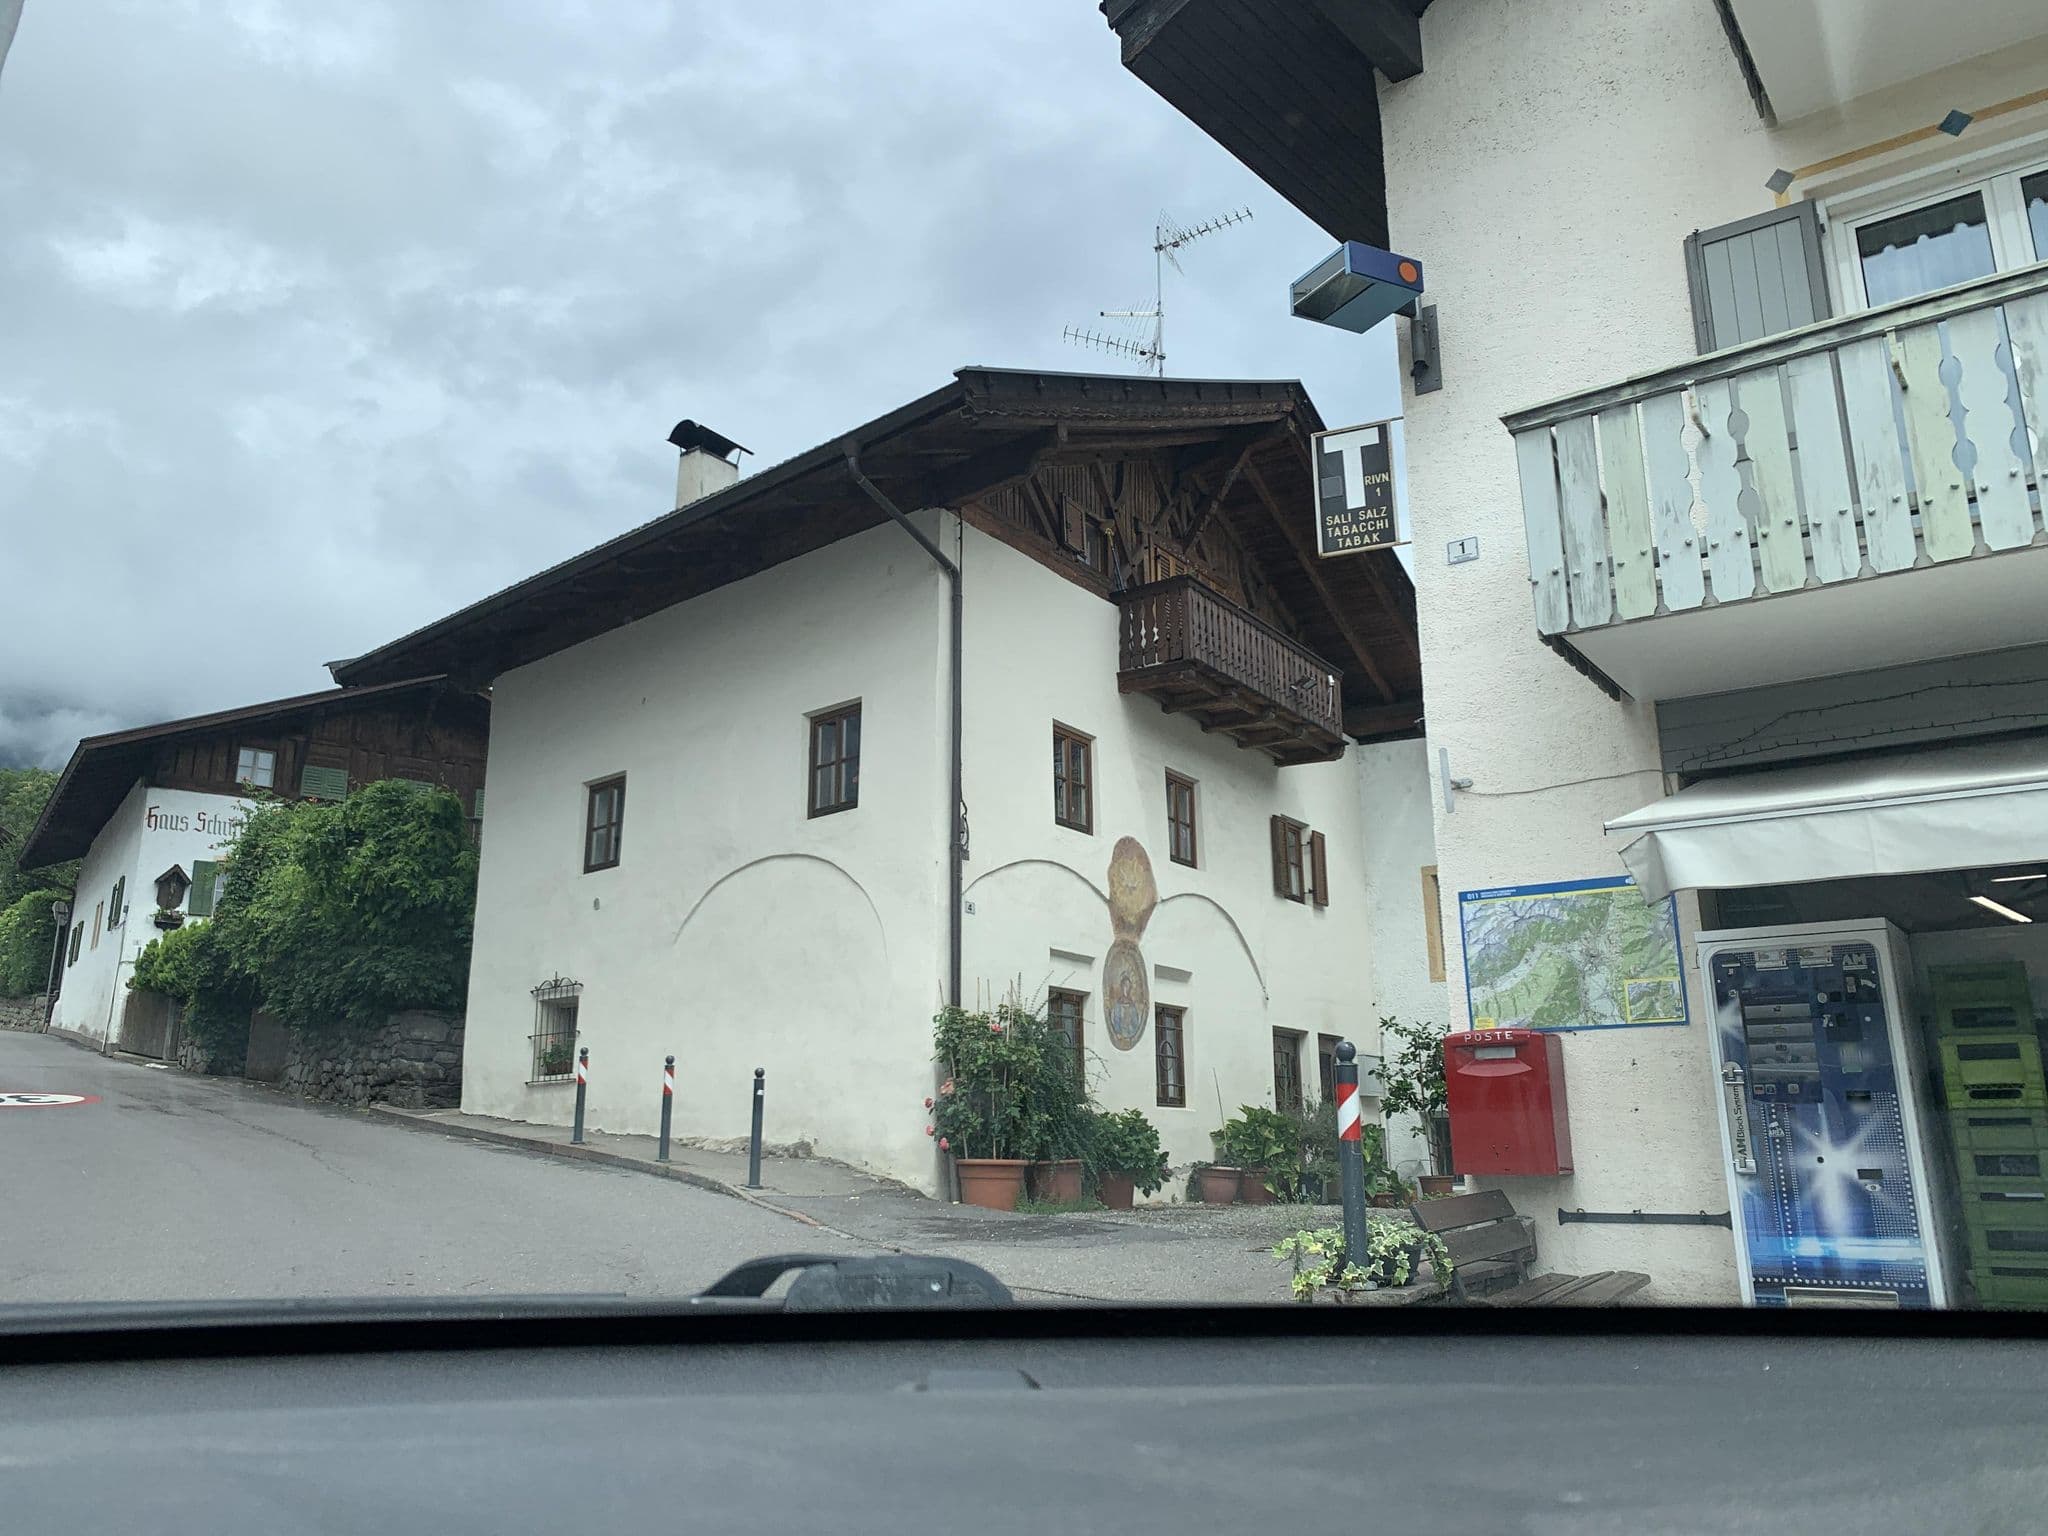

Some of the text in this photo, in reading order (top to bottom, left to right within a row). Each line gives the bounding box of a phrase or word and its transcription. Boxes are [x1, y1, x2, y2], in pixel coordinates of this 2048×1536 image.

[1323, 426, 1380, 510] T
[1375, 487, 1381, 497] 1
[1326, 506, 1388, 526] SALI SALZ
[1327, 518, 1389, 538] TABACCHI
[1337, 532, 1381, 549] TABAK
[1459, 541, 1466, 554] 1
[146, 805, 189, 832] Haus
[1464, 1030, 1514, 1043] POSTE
